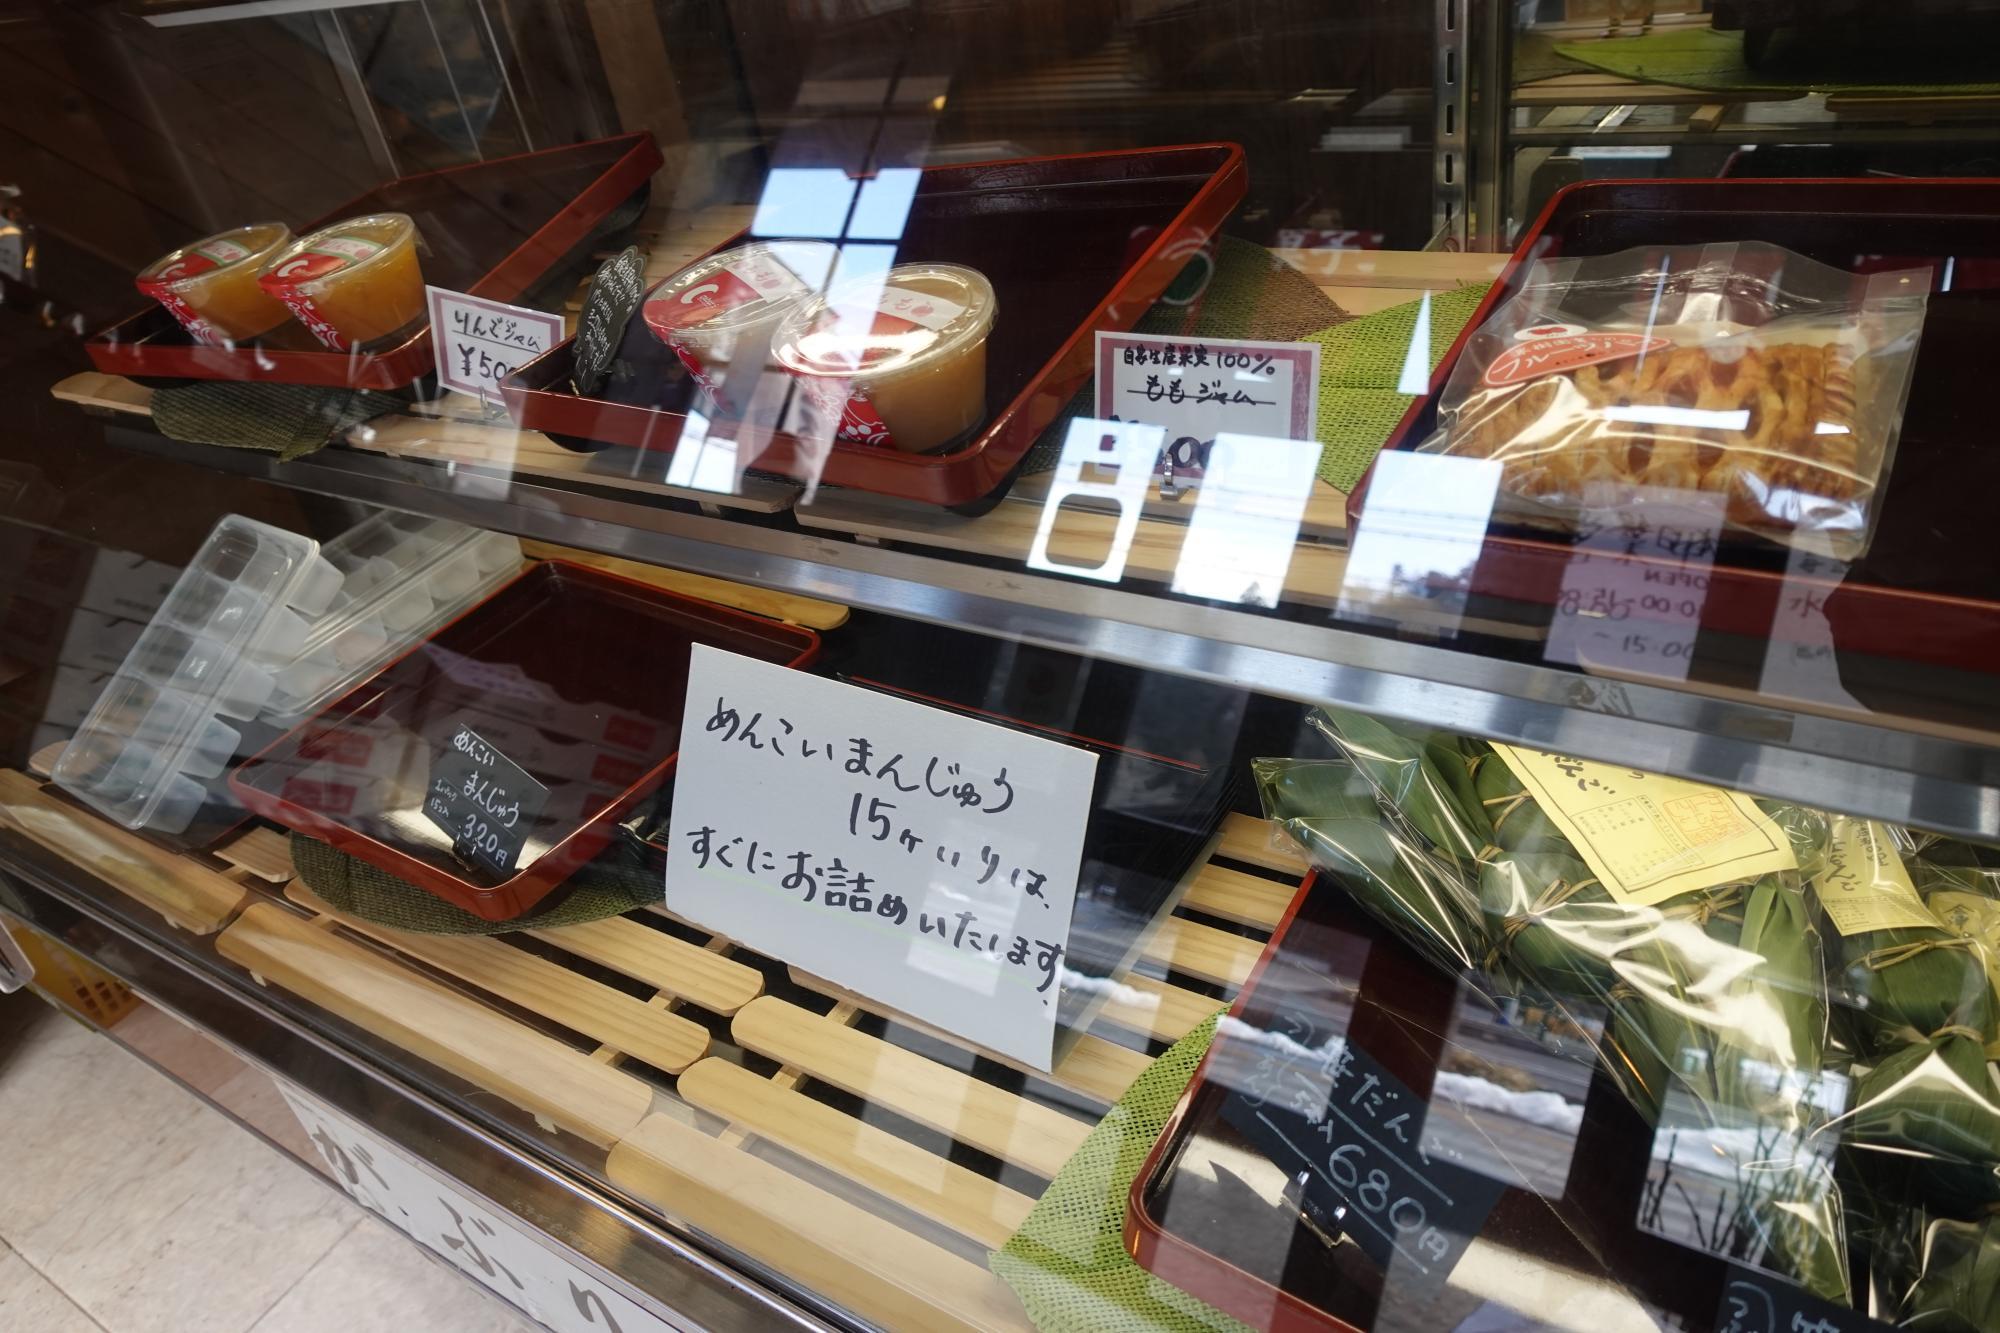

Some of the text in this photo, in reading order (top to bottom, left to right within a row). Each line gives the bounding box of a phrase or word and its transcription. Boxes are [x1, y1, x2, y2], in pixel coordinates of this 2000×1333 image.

[1217, 351, 1276, 375] 100%
[454, 731, 495, 767] めんこい
[705, 697, 1015, 814] めんこいまんじゅう
[463, 770, 520, 828] まんじゅう
[463, 814, 508, 867] 320円
[1328, 1143, 1450, 1262] 680円
